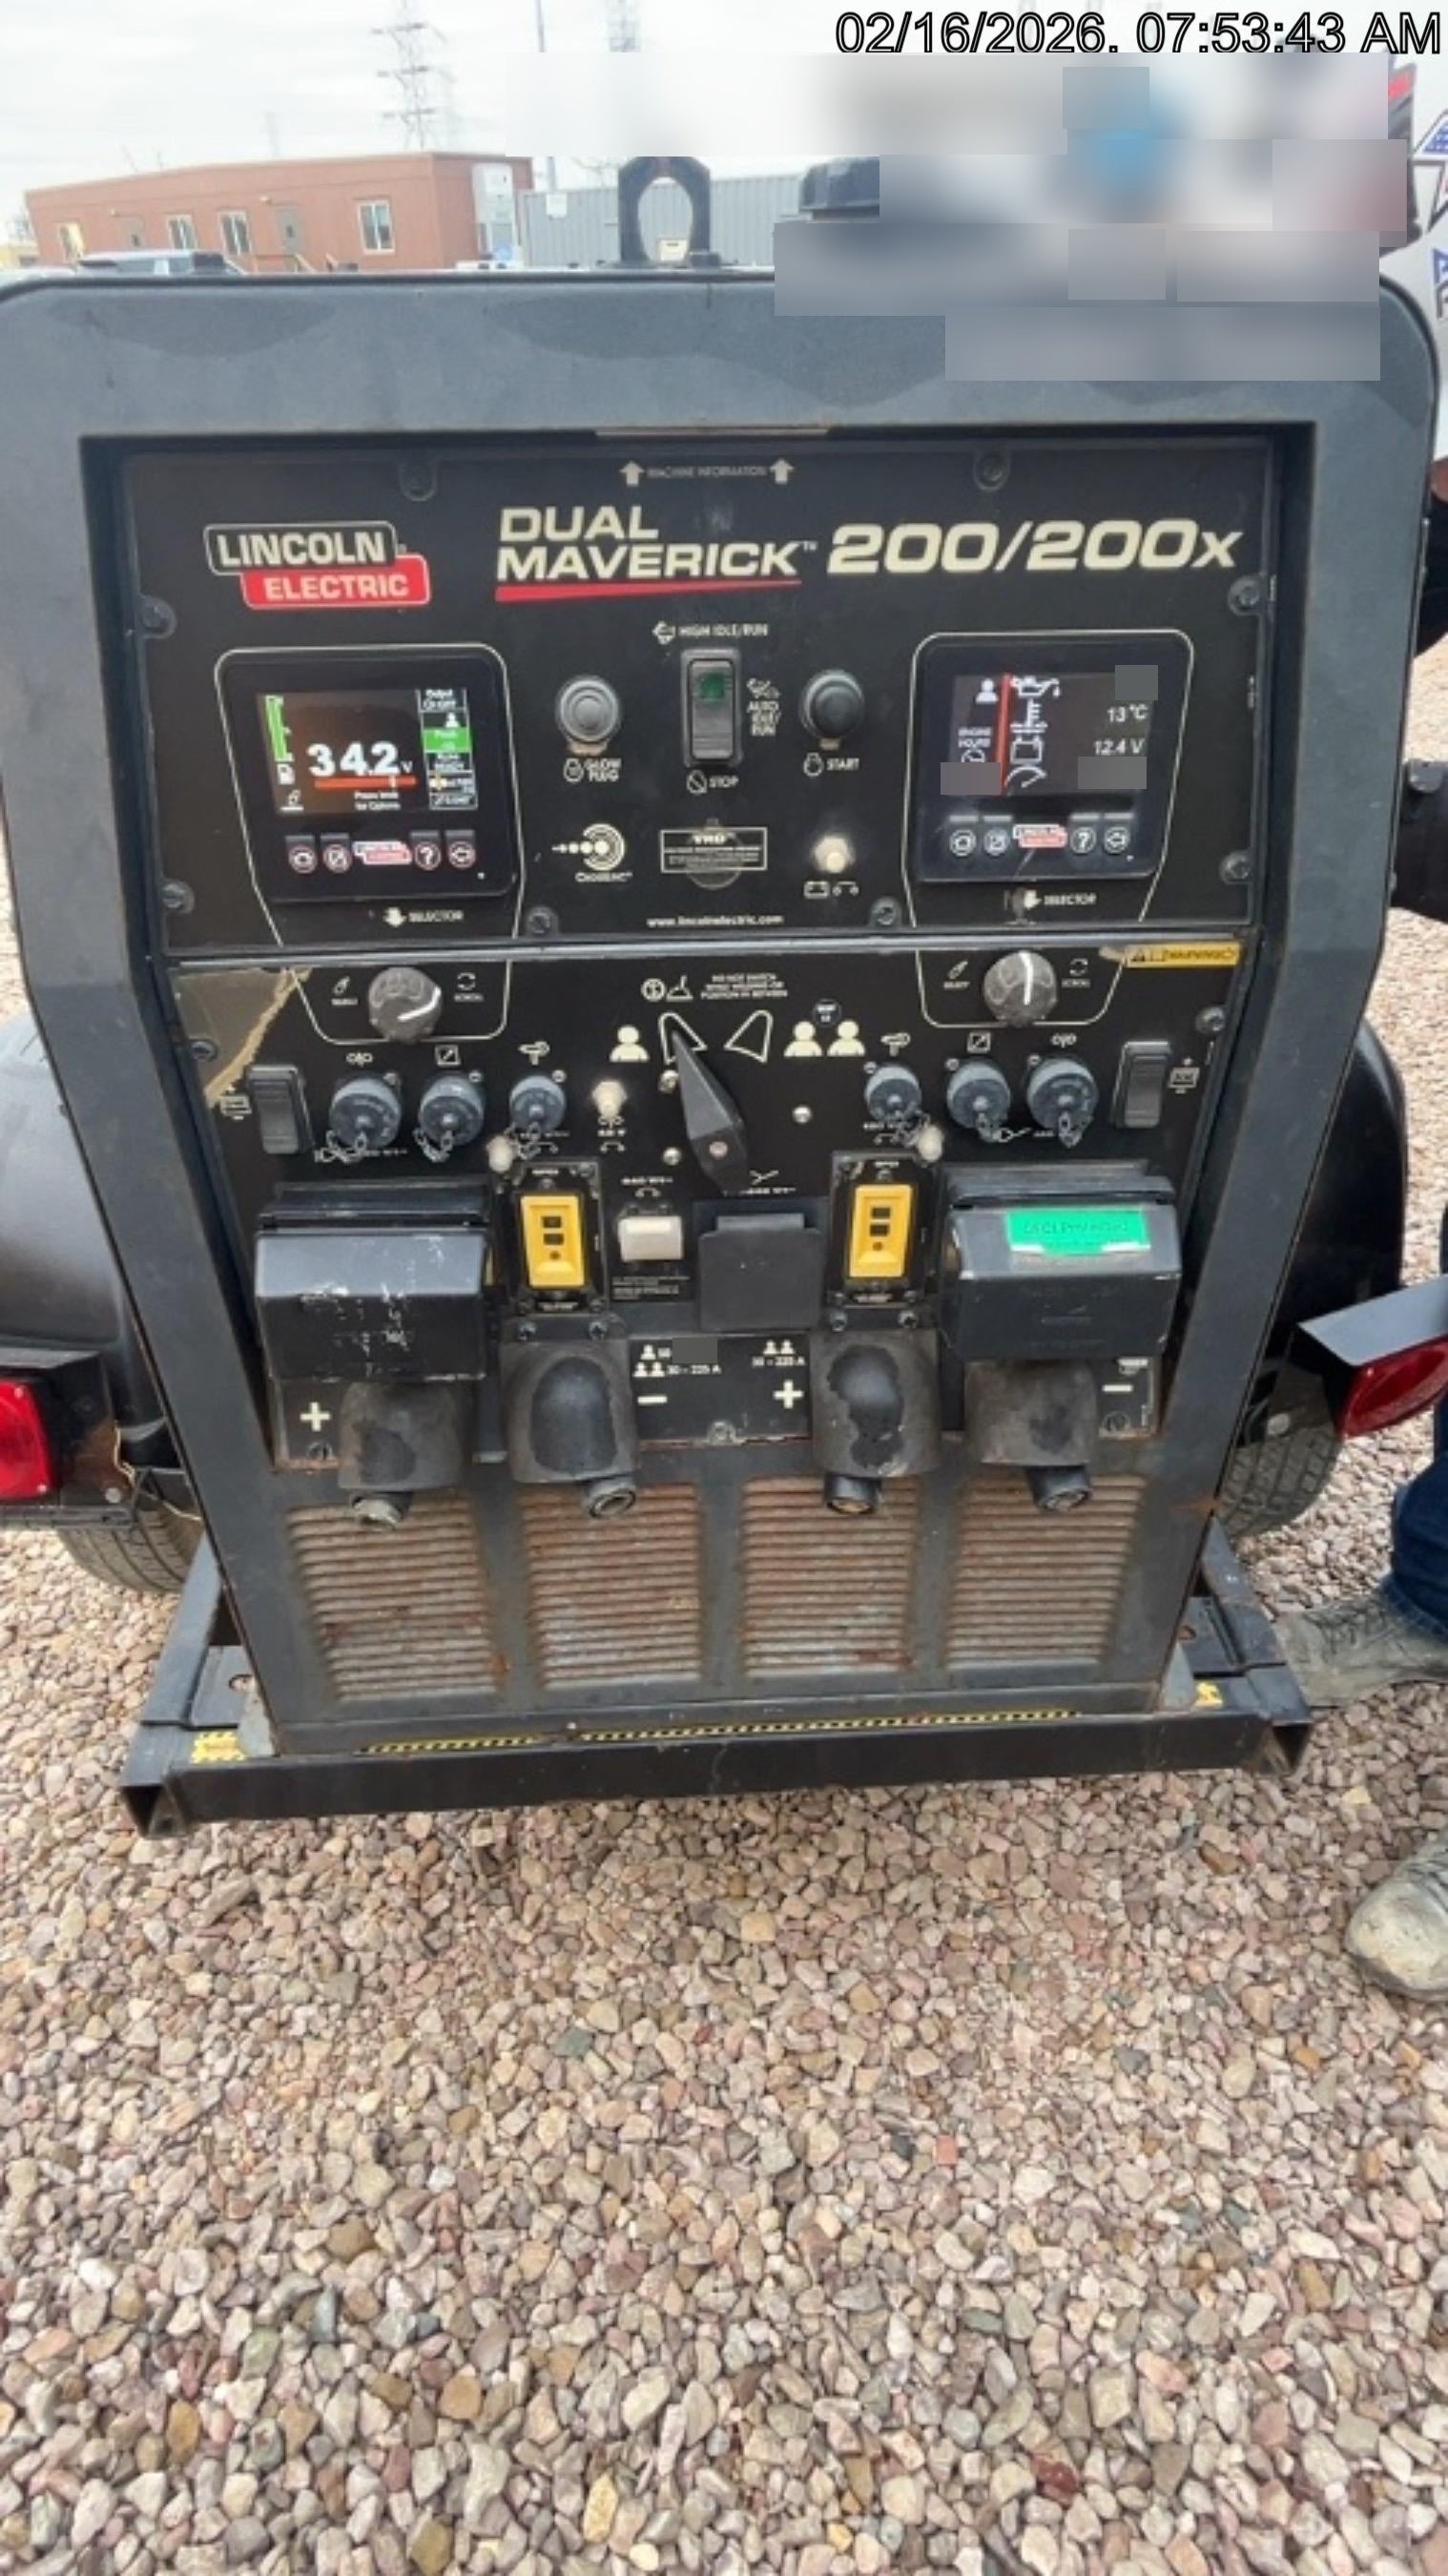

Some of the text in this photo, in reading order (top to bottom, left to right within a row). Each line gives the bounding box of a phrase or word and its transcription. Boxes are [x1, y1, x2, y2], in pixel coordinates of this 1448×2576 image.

[499, 506, 660, 543] DUAL
[216, 531, 388, 568] LINCOLN
[263, 574, 411, 602] ELECTRIC
[678, 623, 769, 637] HIGH IDLE/RUN
[748, 701, 779, 714] AUTO
[750, 724, 776, 737] RUN
[306, 740, 401, 776] 34.2
[826, 758, 859, 771] START
[709, 776, 739, 788] STOP
[1044, 893, 1097, 905] SELECTOR
[408, 909, 464, 923] SELECTOR
[646, 913, 785, 928] www.lincolnelectric.com
